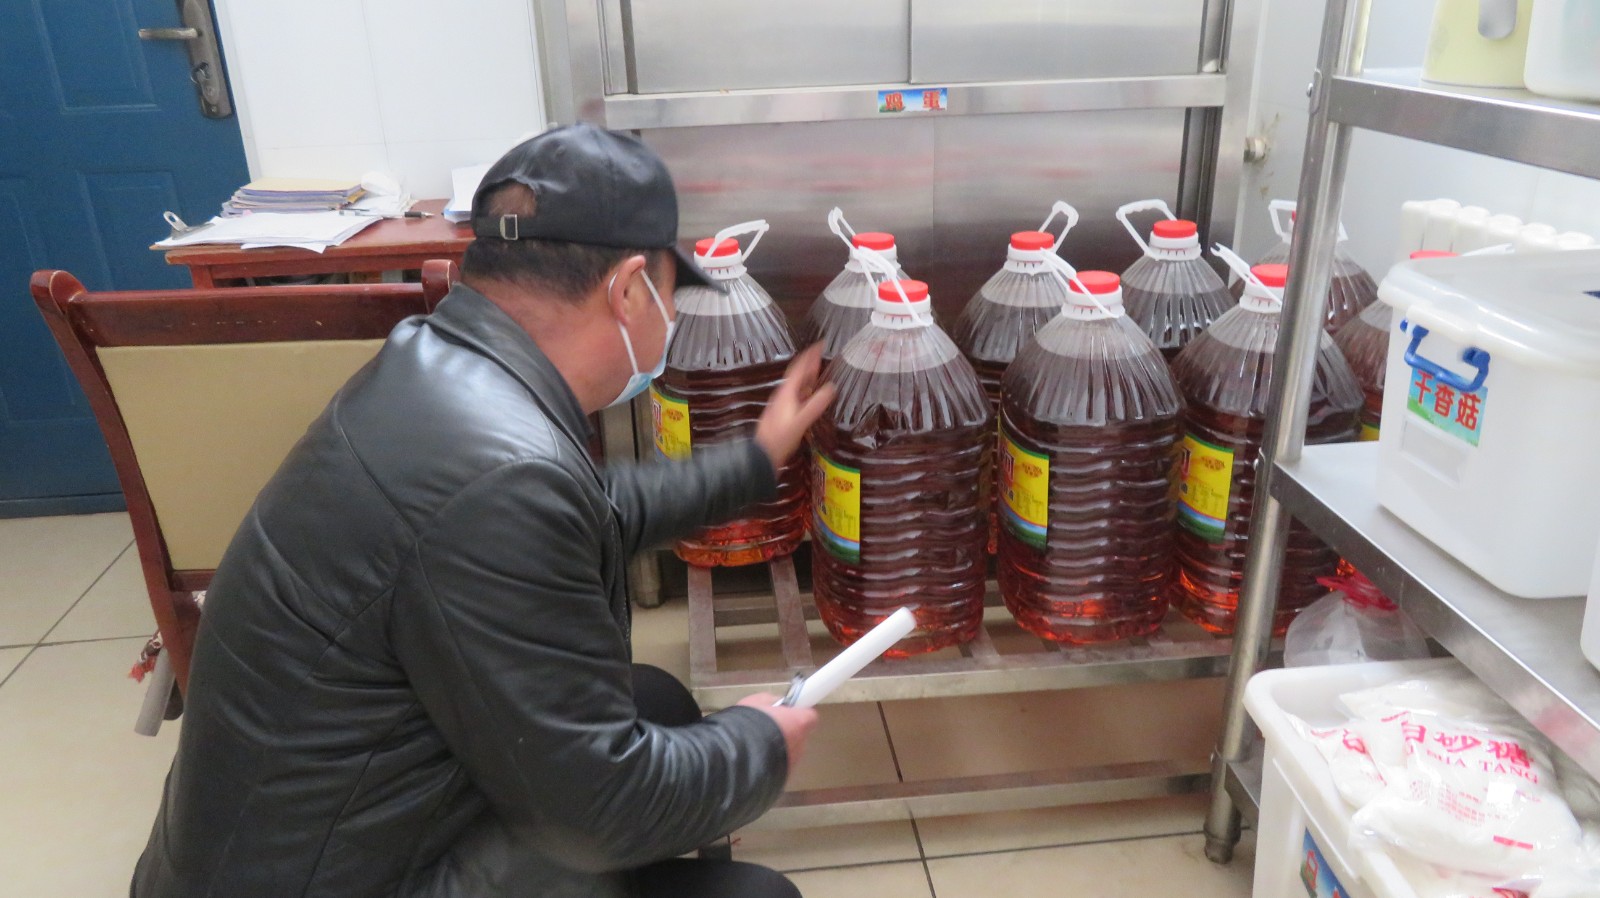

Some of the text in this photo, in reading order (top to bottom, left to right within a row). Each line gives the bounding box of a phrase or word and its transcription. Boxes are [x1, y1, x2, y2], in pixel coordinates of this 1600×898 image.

[1415, 370, 1481, 431] 干香菇
[1478, 759, 1538, 783] TANG
